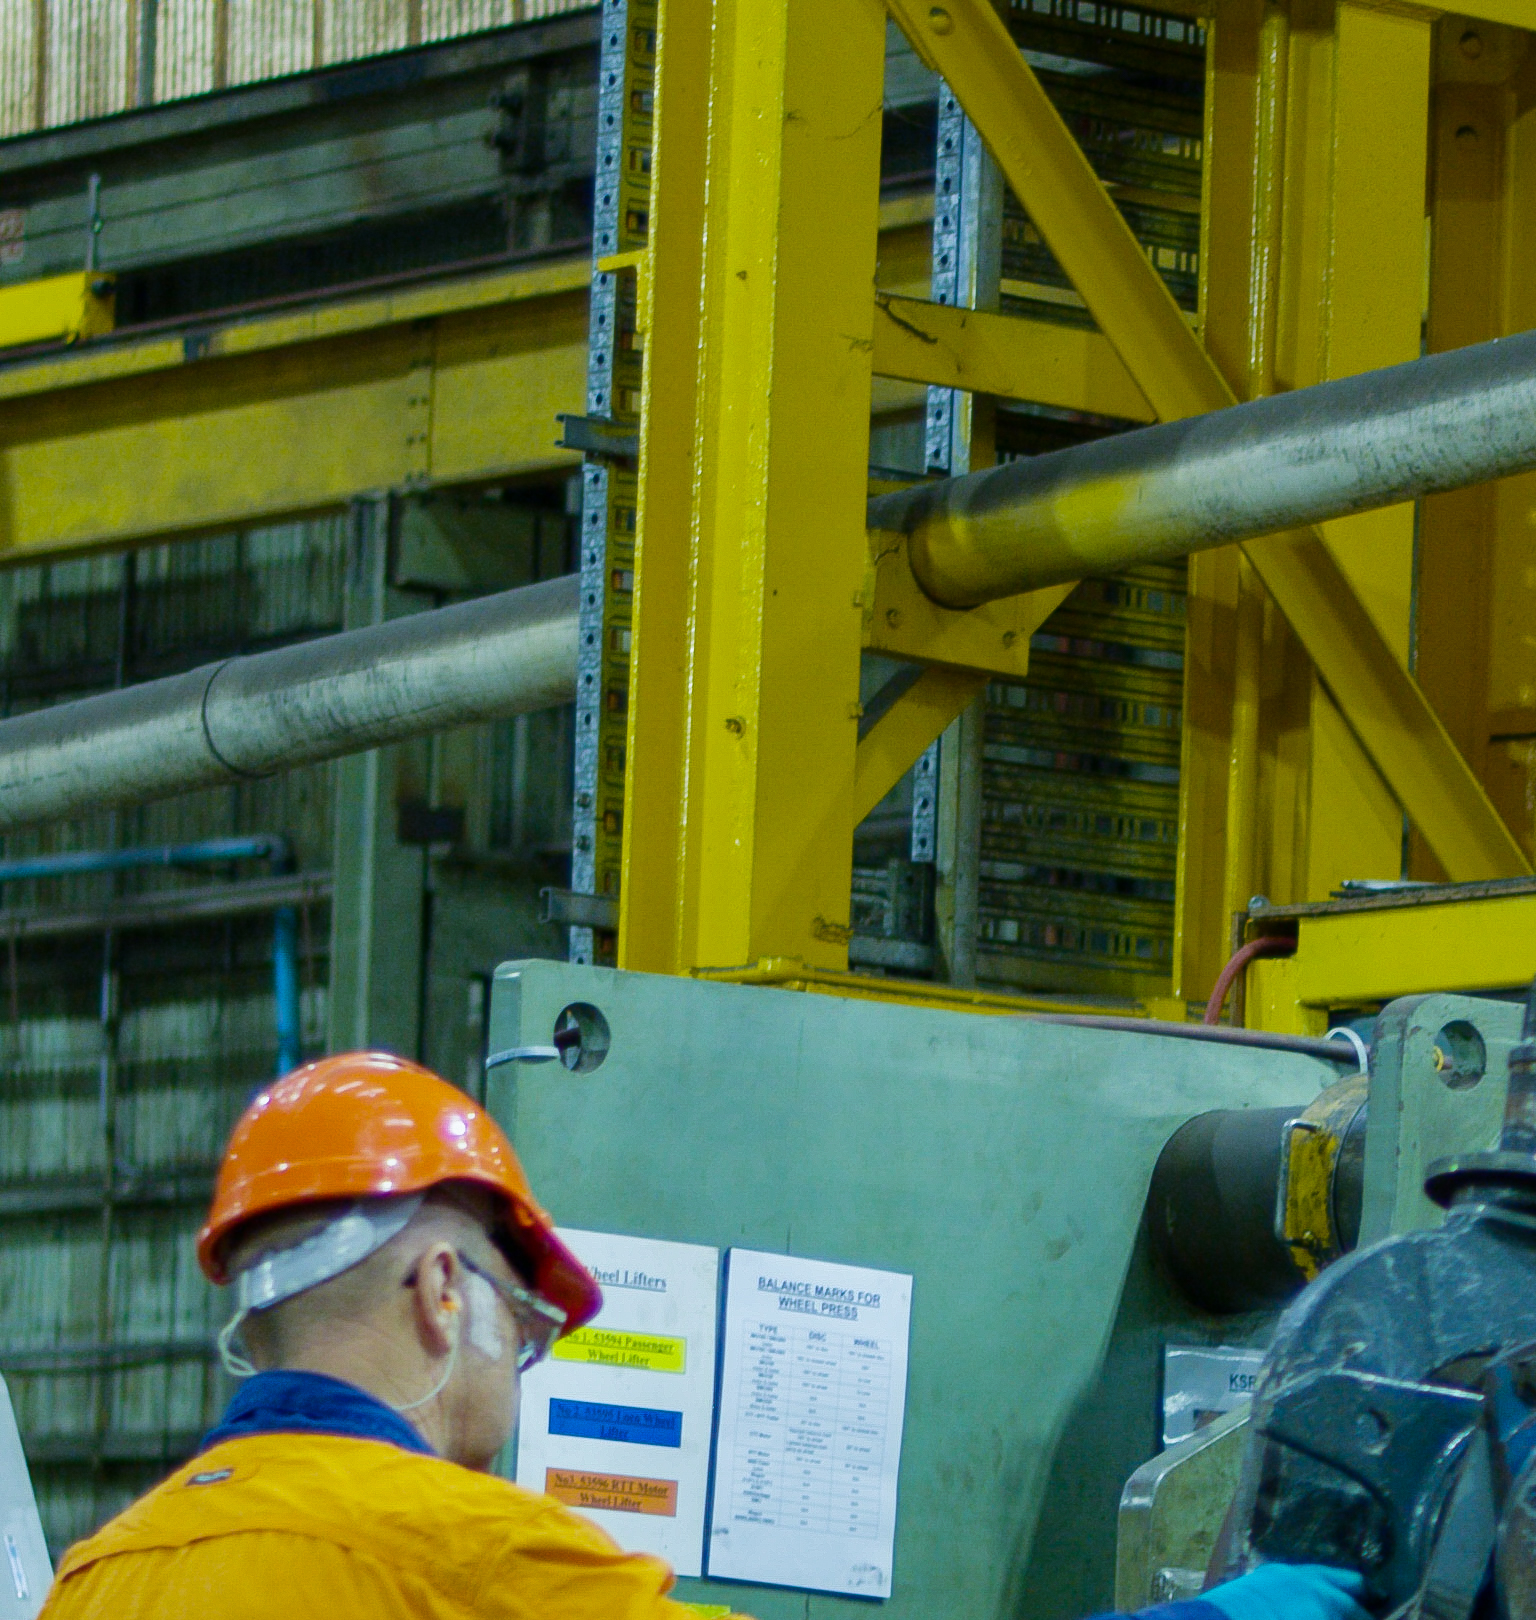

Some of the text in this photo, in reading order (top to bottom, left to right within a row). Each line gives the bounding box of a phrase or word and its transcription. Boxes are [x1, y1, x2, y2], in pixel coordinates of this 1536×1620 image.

[591, 1266, 667, 1289] heel Lifters
[758, 1276, 881, 1306] BALANCE MARKS FOR
[779, 1296, 858, 1319] WHEEL PRESS
[588, 1349, 619, 1362] Wheel
[639, 1482, 669, 1497] Motor
